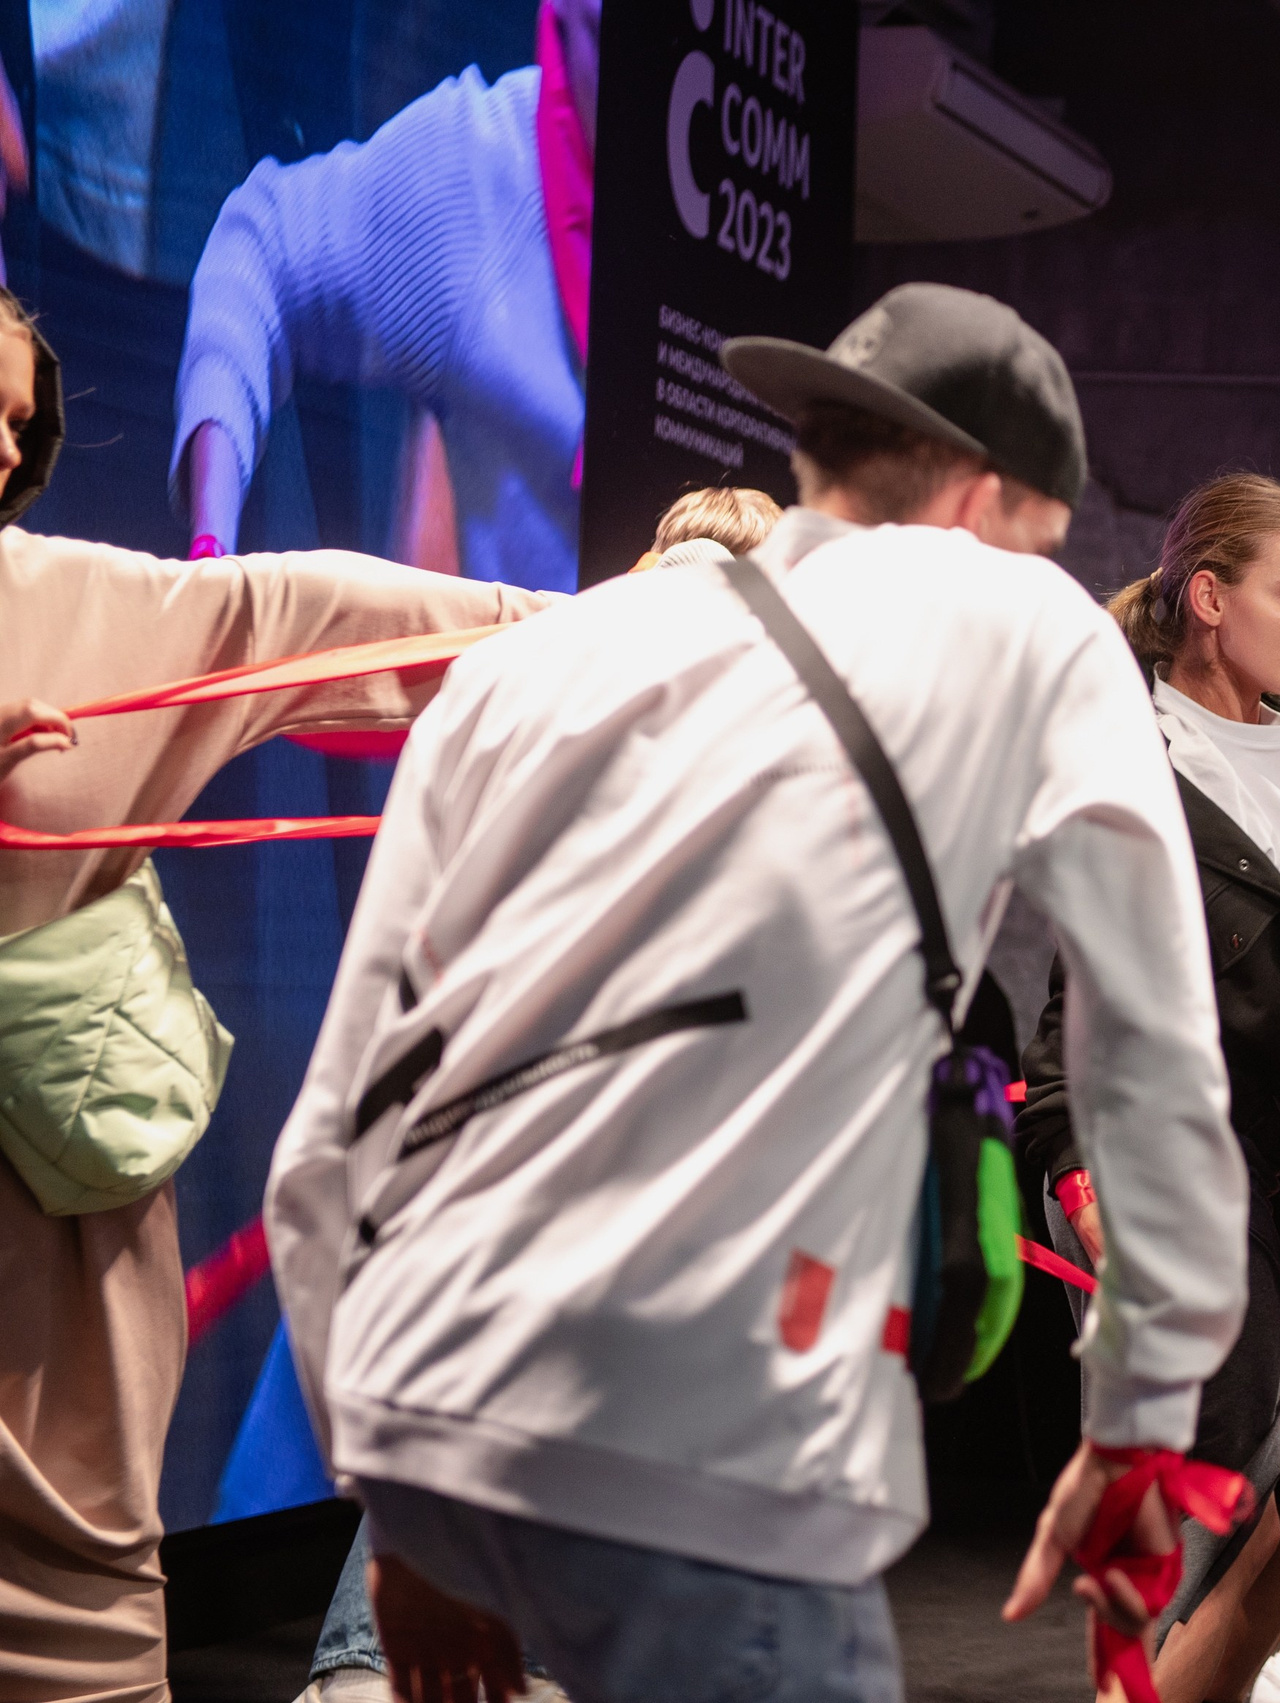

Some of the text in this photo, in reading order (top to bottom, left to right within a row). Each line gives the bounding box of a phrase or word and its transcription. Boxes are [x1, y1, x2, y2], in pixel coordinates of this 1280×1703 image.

[723, 0, 807, 105] INTER
[721, 81, 811, 201] COMM
[717, 177, 792, 280] 2023
[656, 377, 665, 401] В
[667, 381, 716, 421] ОБЛАСТИ
[657, 340, 668, 365] И
